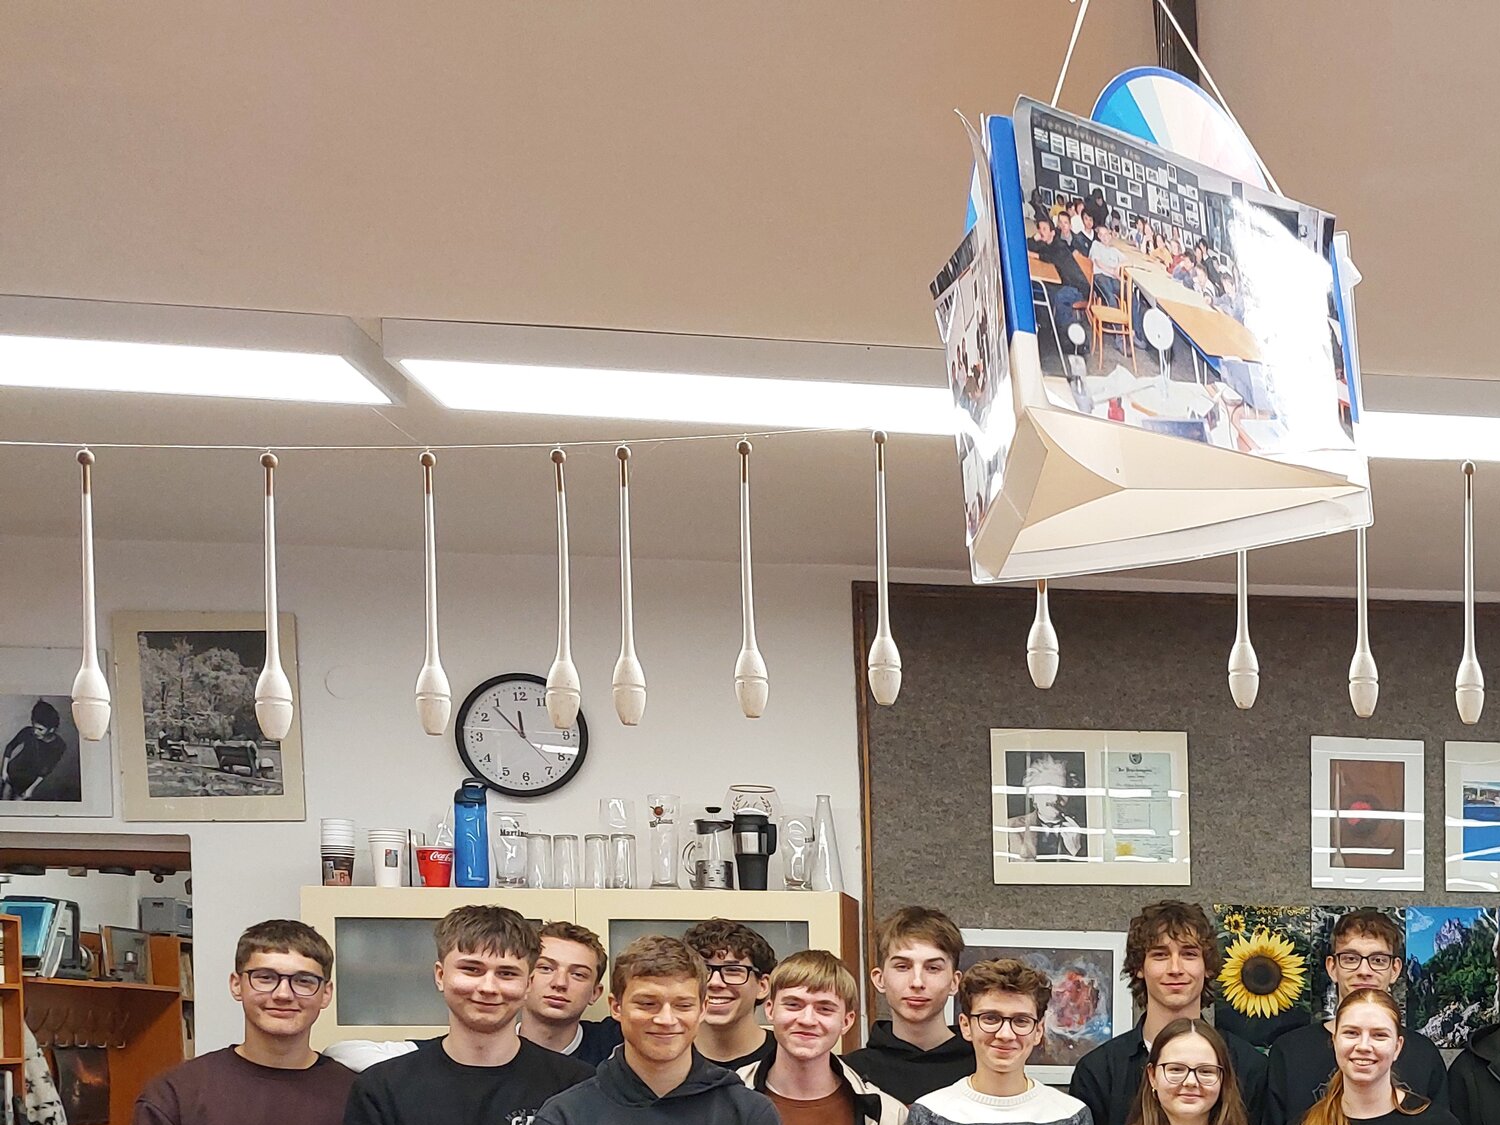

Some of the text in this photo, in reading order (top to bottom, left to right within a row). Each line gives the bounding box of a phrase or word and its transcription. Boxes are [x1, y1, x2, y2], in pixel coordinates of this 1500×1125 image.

[513, 692, 528, 702] 12
[495, 698, 500, 708] 1
[536, 698, 546, 708] 11
[481, 713, 490, 722] 2
[476, 732, 484, 742] 3
[562, 731, 570, 741] 9
[484, 753, 492, 763] 4
[557, 753, 566, 762] 8
[502, 767, 510, 777] 5
[545, 767, 553, 776] 7
[522, 772, 530, 782] 6
